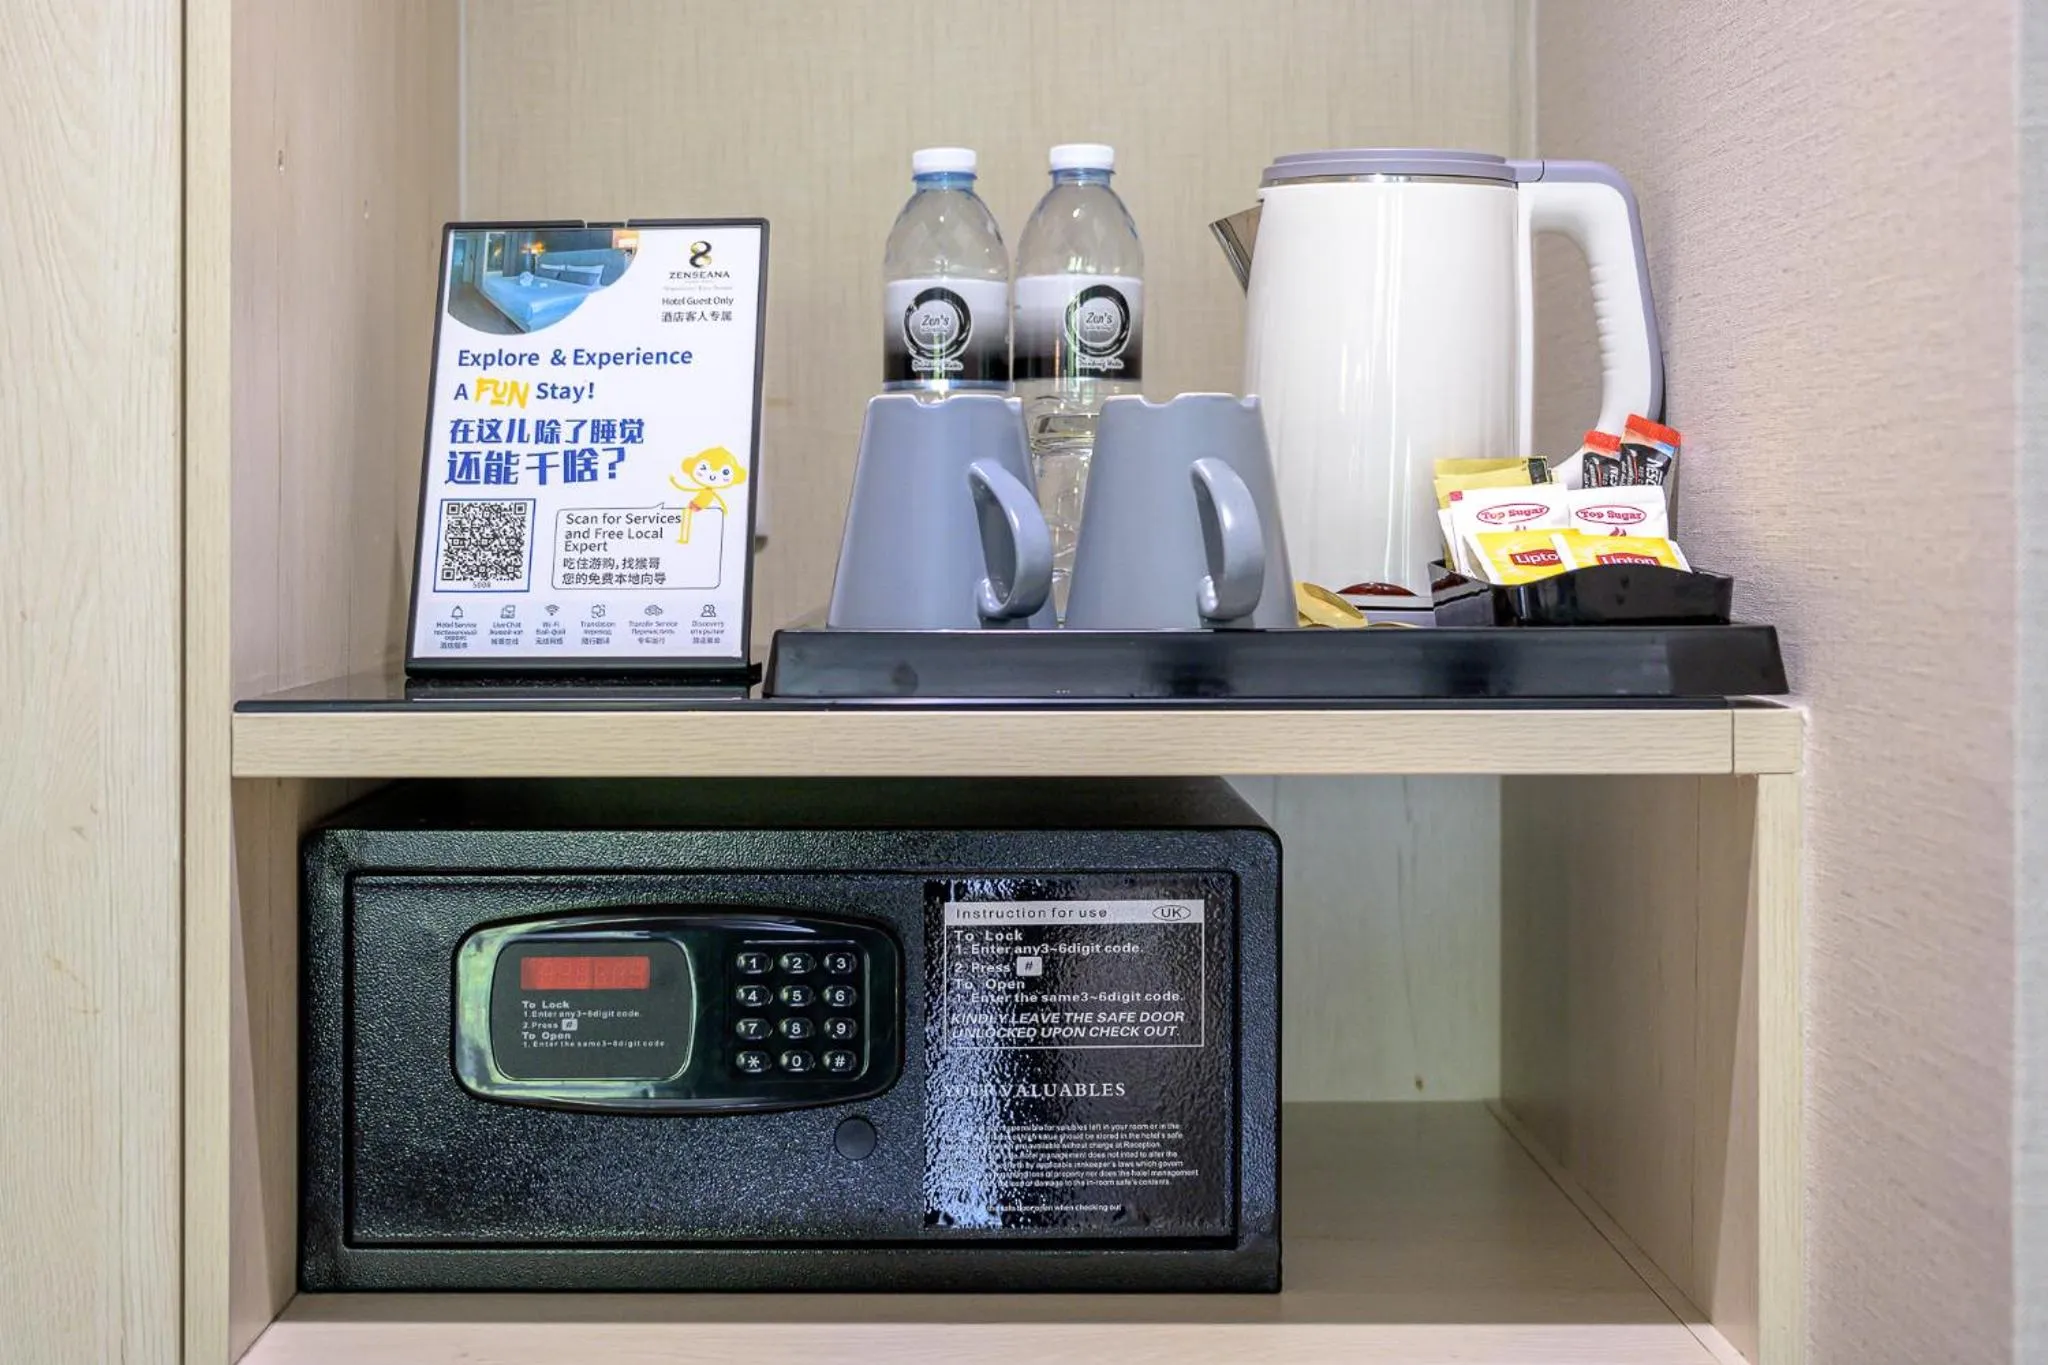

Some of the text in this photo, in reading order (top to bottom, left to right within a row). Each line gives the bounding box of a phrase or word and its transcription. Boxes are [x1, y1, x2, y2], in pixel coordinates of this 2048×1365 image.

[669, 271, 731, 279] ZENSEANA
[661, 295, 734, 306] Hotel Guest Only
[661, 311, 733, 322] 酒店客人专属
[921, 314, 950, 326] Zen's
[1086, 312, 1113, 324] Zen's
[457, 347, 693, 370] Explore & Experience
[453, 377, 595, 408] A FUN Stay!
[449, 418, 645, 445] 在这儿除了睡觉
[444, 447, 626, 485] 还能干啥？
[566, 512, 682, 525] Scan for Services
[1481, 506, 1546, 520] Top Sugar
[1580, 510, 1643, 521] Top Sugar
[565, 527, 663, 539] and Free Local
[564, 541, 608, 554] Expert
[1515, 552, 1559, 564] Lipto
[562, 572, 667, 585] 您的免费本地向导
[957, 906, 1108, 919] Instruction for use
[1161, 908, 1182, 918] UK
[954, 929, 1024, 942] To Lock
[971, 943, 1010, 955] Enter
[750, 958, 757, 968] 1
[792, 958, 802, 968] 2
[836, 958, 846, 969] 3
[971, 962, 1012, 974] Press
[1024, 961, 1034, 971] #
[985, 978, 1026, 994] Open
[747, 990, 758, 1001] 4
[792, 990, 802, 1001] 5
[835, 990, 845, 1002] 6
[1014, 993, 1039, 1003] the
[522, 1000, 570, 1009] To Lock
[1063, 1012, 1094, 1024] THE
[1097, 1012, 1137, 1024] SAFE
[1139, 1011, 1185, 1023] DOOR
[747, 1023, 758, 1034] 7
[791, 1022, 801, 1035] 8
[835, 1022, 846, 1035] 9
[1041, 1027, 1086, 1039] UPON
[1089, 1026, 1140, 1038] CHECK
[1143, 1026, 1181, 1037] OUT.
[522, 1031, 572, 1041] To Open
[791, 1055, 802, 1067] 0
[834, 1055, 846, 1067] #
[999, 1082, 1127, 1098] VALUABLES
